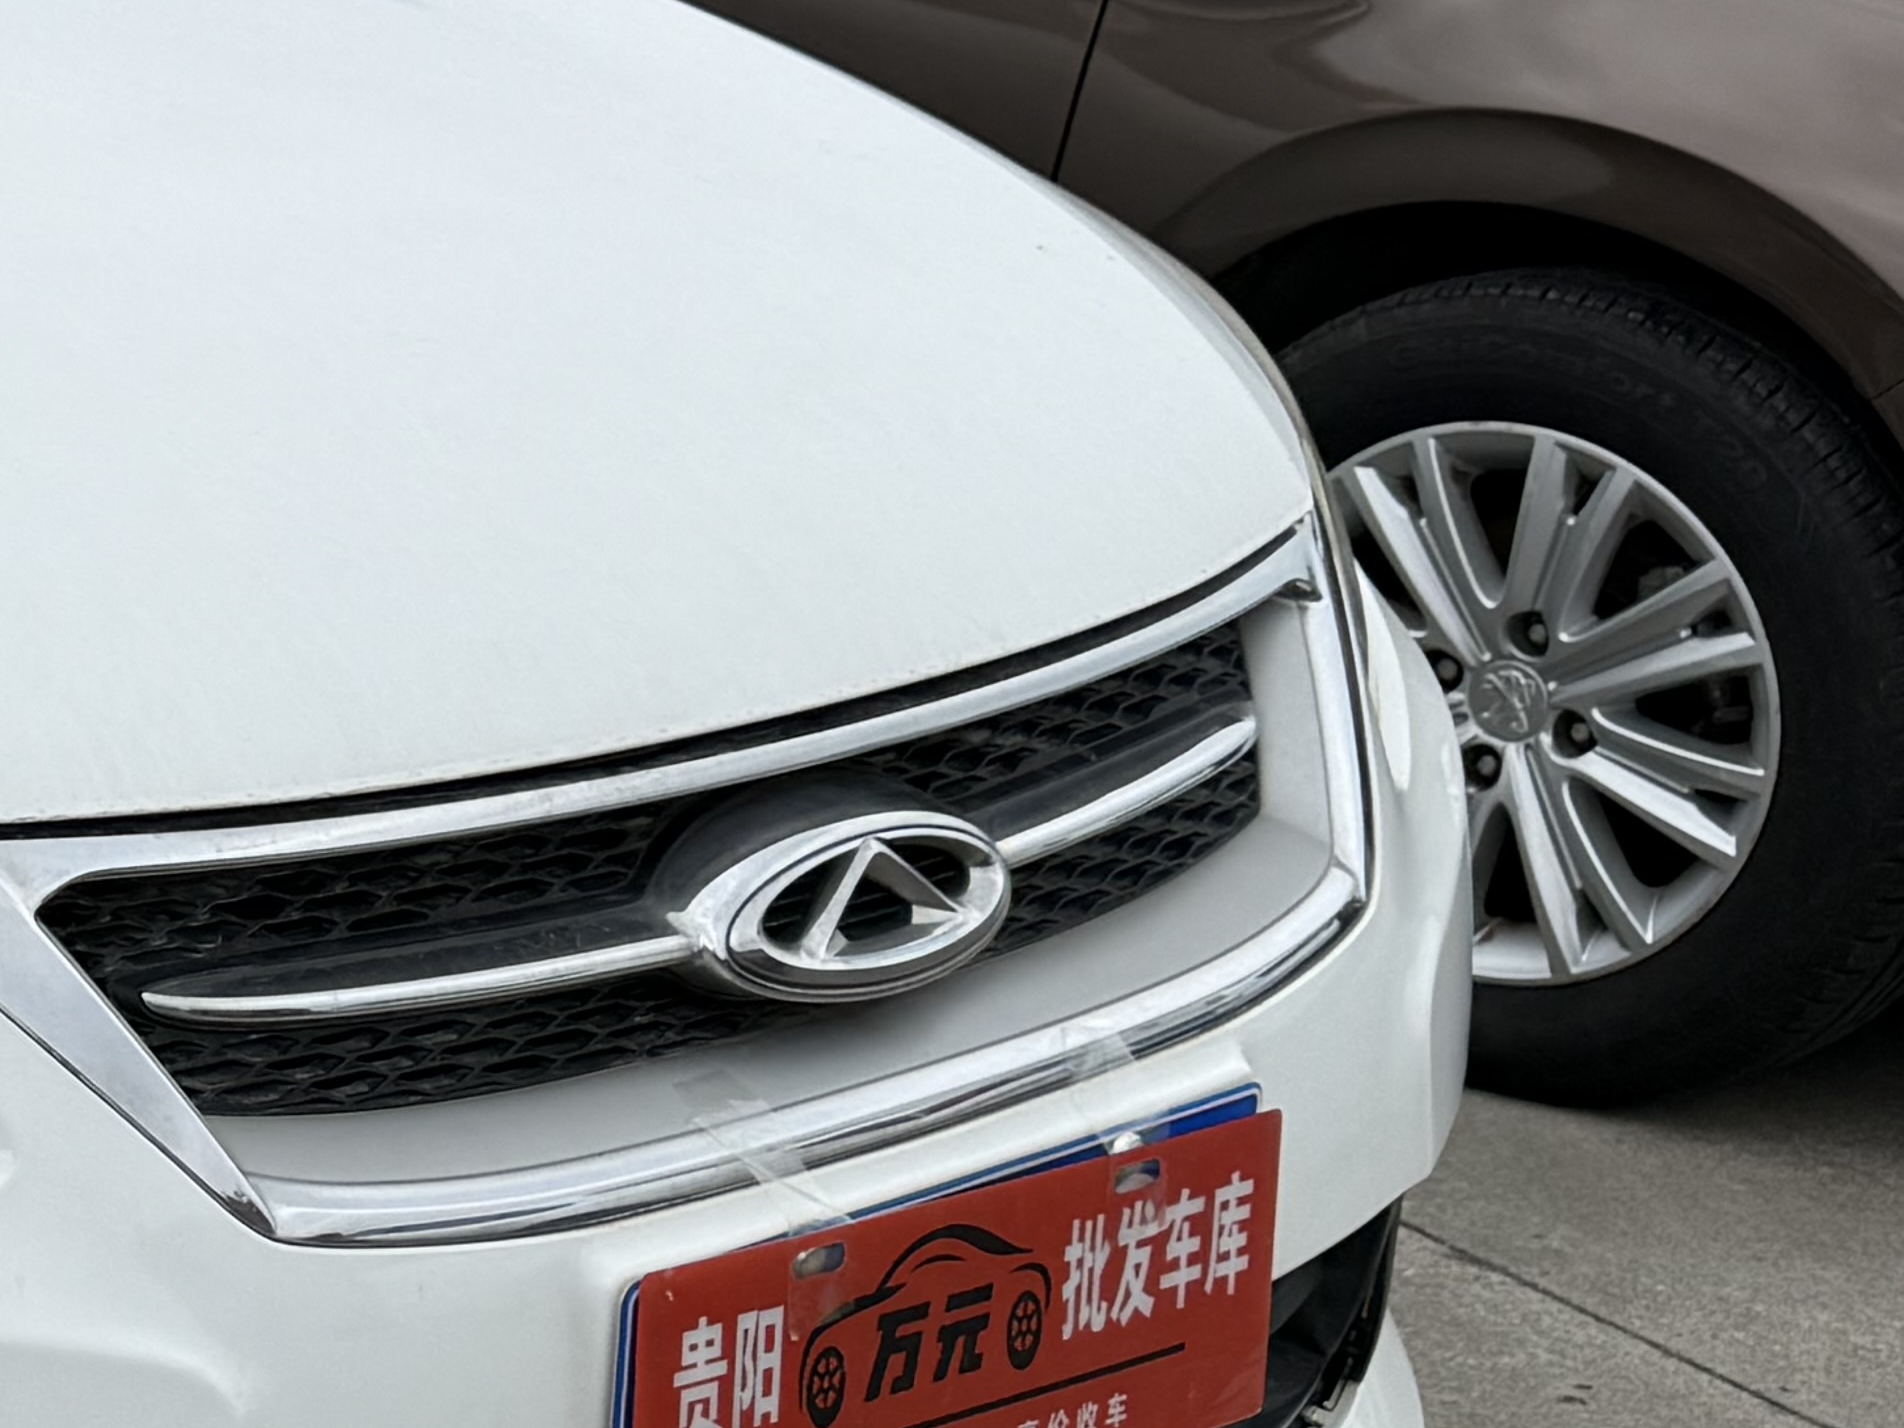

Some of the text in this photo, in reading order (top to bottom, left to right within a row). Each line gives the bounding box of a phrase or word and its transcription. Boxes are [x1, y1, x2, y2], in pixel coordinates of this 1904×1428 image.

[863, 1283, 993, 1404] 万元
[1060, 1170, 1255, 1341] 批发车库
